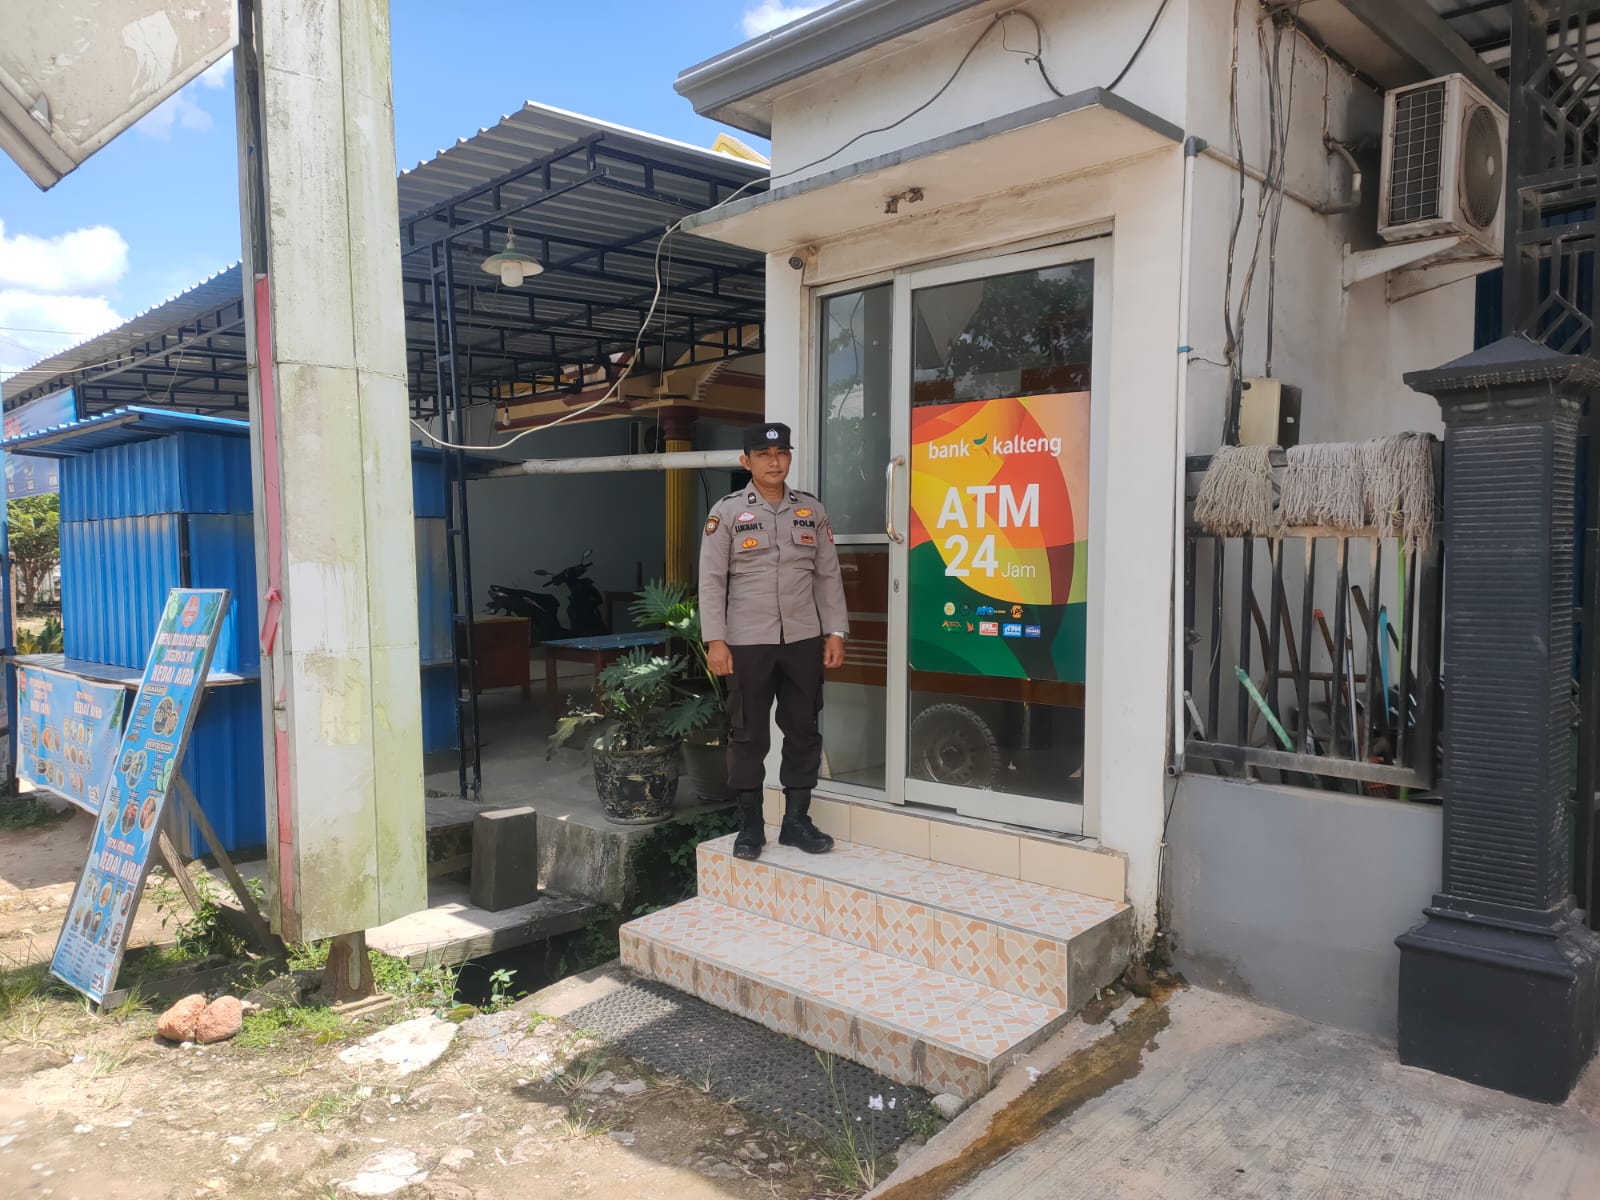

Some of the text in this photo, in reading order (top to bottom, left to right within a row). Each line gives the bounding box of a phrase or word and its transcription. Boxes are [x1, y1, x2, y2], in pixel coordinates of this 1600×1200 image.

[928, 434, 1062, 459] bank kalteng
[936, 483, 1040, 529] ATM
[944, 534, 1036, 578] 24 Jam
